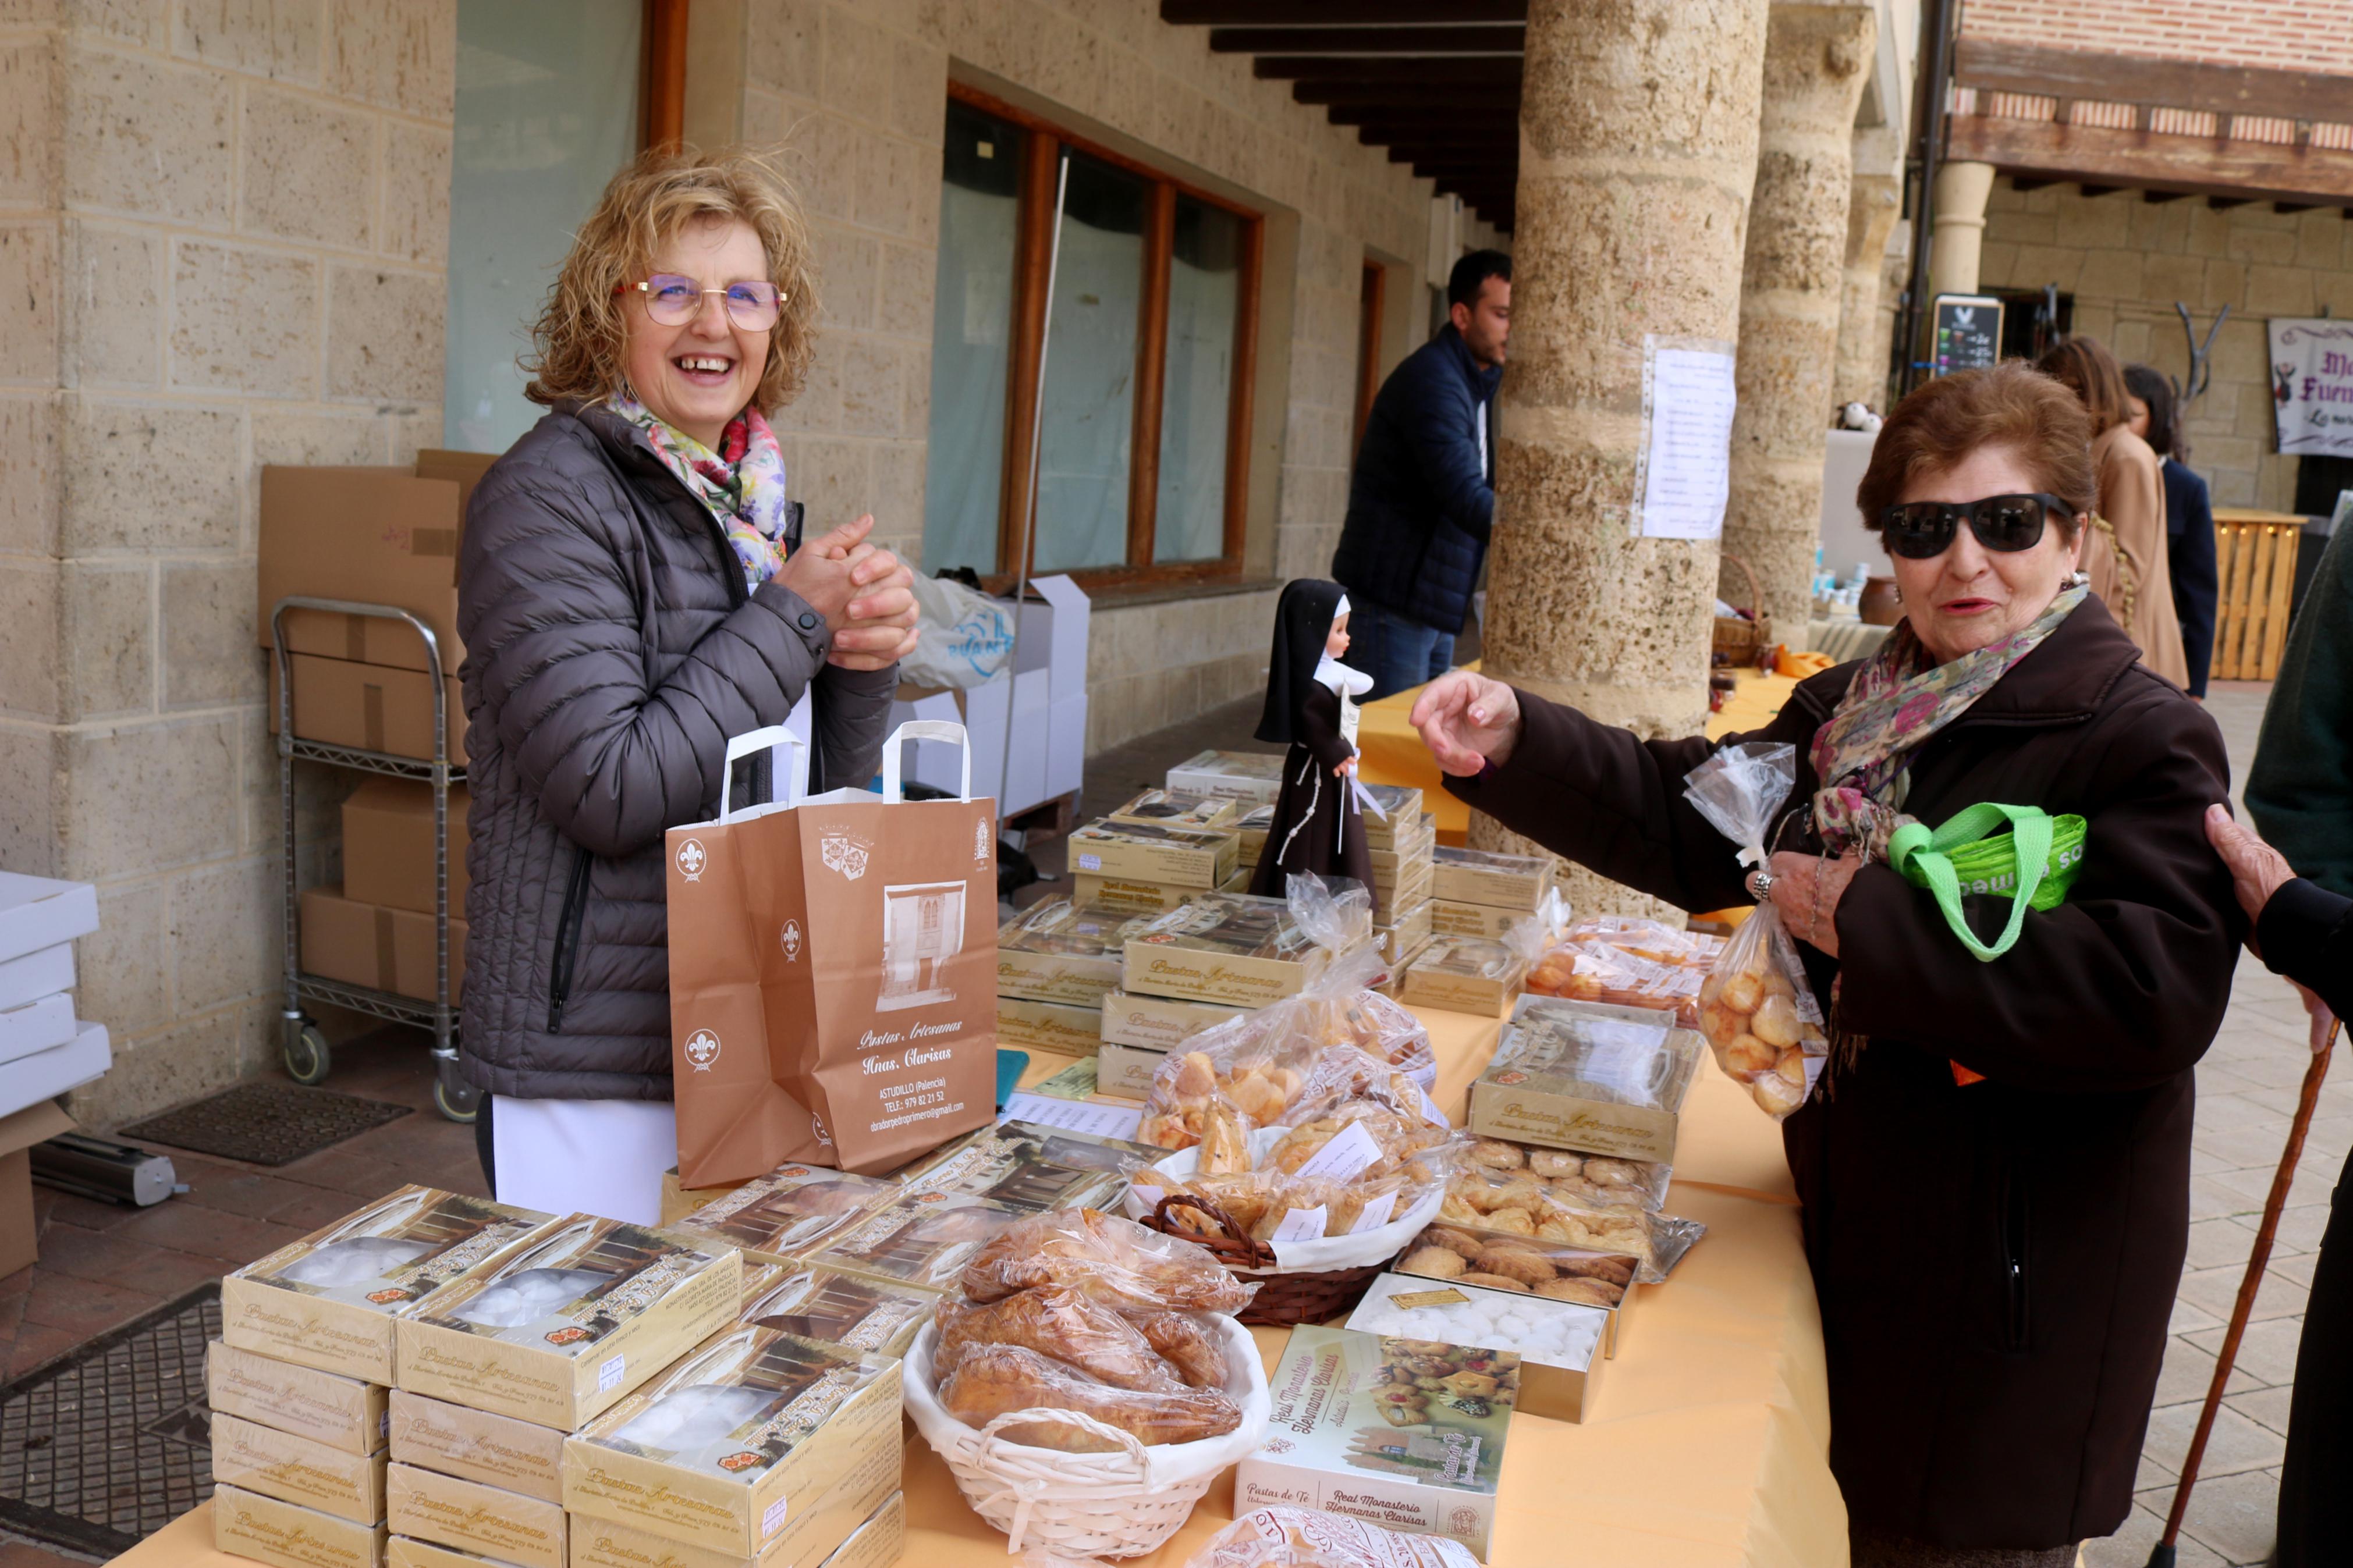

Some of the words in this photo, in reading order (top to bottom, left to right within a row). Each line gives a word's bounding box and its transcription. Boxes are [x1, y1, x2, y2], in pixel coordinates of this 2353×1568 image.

[1149, 959, 1201, 978] Pastas
[1204, 967, 1283, 989] Artesanas
[857, 1029, 900, 1050] Pastas
[902, 1021, 962, 1041] Artesanas
[863, 1055, 900, 1075] Hnas.
[904, 1047, 952, 1068] Clarisas
[879, 1083, 914, 1099] ASTUDILLO
[915, 1077, 946, 1093] (Palencia)
[904, 1097, 917, 1108] 979
[918, 1095, 926, 1105] 82
[928, 1093, 935, 1103] 21
[936, 1091, 944, 1101] 52
[870, 1101, 964, 1132] obradorpedroprimero@gmail.com
[243, 1303, 297, 1328] Pastas
[297, 1318, 378, 1348] Artesanas
[418, 1346, 476, 1371] Pastas
[476, 1360, 560, 1392] Artesanas
[1279, 1355, 1313, 1402] Monasterio
[1291, 1388, 1326, 1435] Hermanas
[1310, 1354, 1339, 1386] Clarisas
[1269, 1402, 1296, 1424] Real
[585, 1467, 645, 1495] Pastas
[645, 1485, 735, 1519] Artesanas
[1247, 1482, 1279, 1498] Pastas
[1281, 1488, 1294, 1500] de
[1297, 1490, 1309, 1503] Té
[1334, 1489, 1359, 1504] Real
[1360, 1495, 1421, 1513] Monasterio
[409, 1489, 464, 1516] Pastas
[464, 1507, 548, 1541] Artesanas
[1325, 1501, 1382, 1519] Hermanas
[1383, 1510, 1428, 1527] Clarisas
[592, 1536, 652, 1565] Pastas
